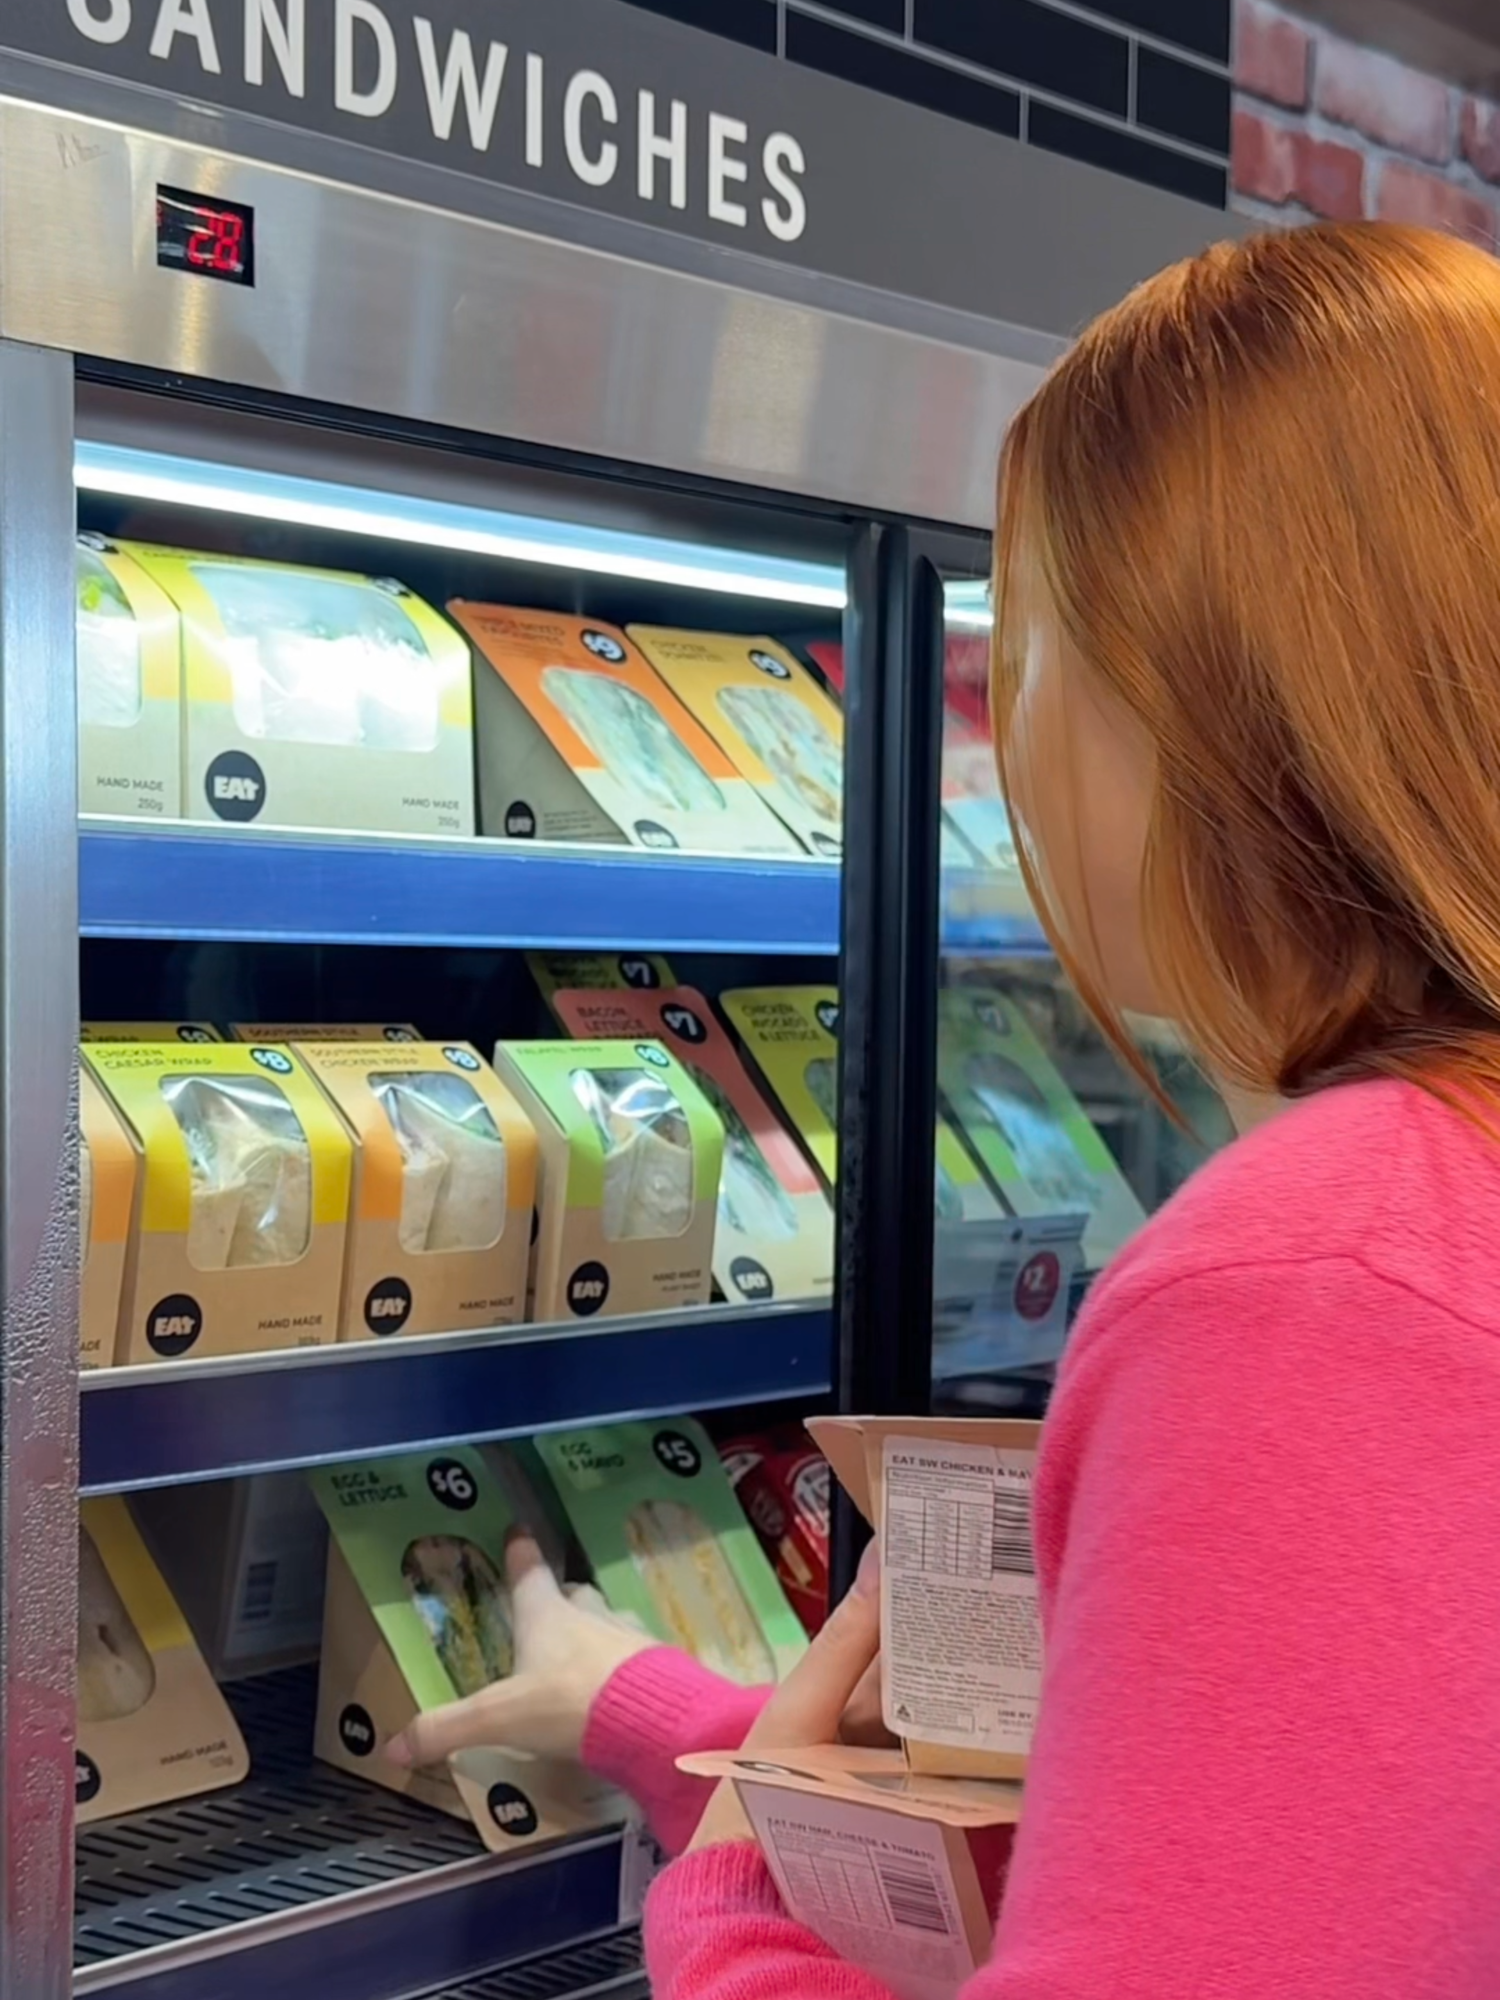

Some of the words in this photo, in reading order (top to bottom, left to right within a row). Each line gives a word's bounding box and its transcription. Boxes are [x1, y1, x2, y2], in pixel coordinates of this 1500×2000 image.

[97, 776, 130, 788] HAND
[133, 779, 164, 791] MADE
[214, 776, 259, 801] EAT
[664, 1010, 698, 1037] $7
[96, 1049, 164, 1059] CHICKEN
[104, 1058, 165, 1070] CAESAR
[167, 1057, 213, 1067] WRAP
[253, 1050, 291, 1071] $8
[572, 1280, 605, 1299] EAT
[370, 1297, 407, 1318] EAT
[459, 1300, 487, 1311] HAND
[155, 1315, 195, 1337] EAT
[257, 1318, 290, 1330] HAND
[293, 1315, 323, 1327] MADE
[79, 1340, 101, 1352] ADE
[560, 1442, 592, 1456] EGG
[657, 1440, 696, 1468] $5
[892, 1454, 916, 1466] EAT
[918, 1458, 938, 1469] SW
[940, 1460, 994, 1477] CHICKEN
[996, 1467, 1005, 1477] &
[330, 1472, 365, 1490] EGG
[367, 1470, 380, 1485] &
[431, 1467, 473, 1499] $6
[338, 1484, 409, 1507] LETTUCE
[159, 1748, 194, 1766] HAND
[494, 1802, 528, 1824] EAT
